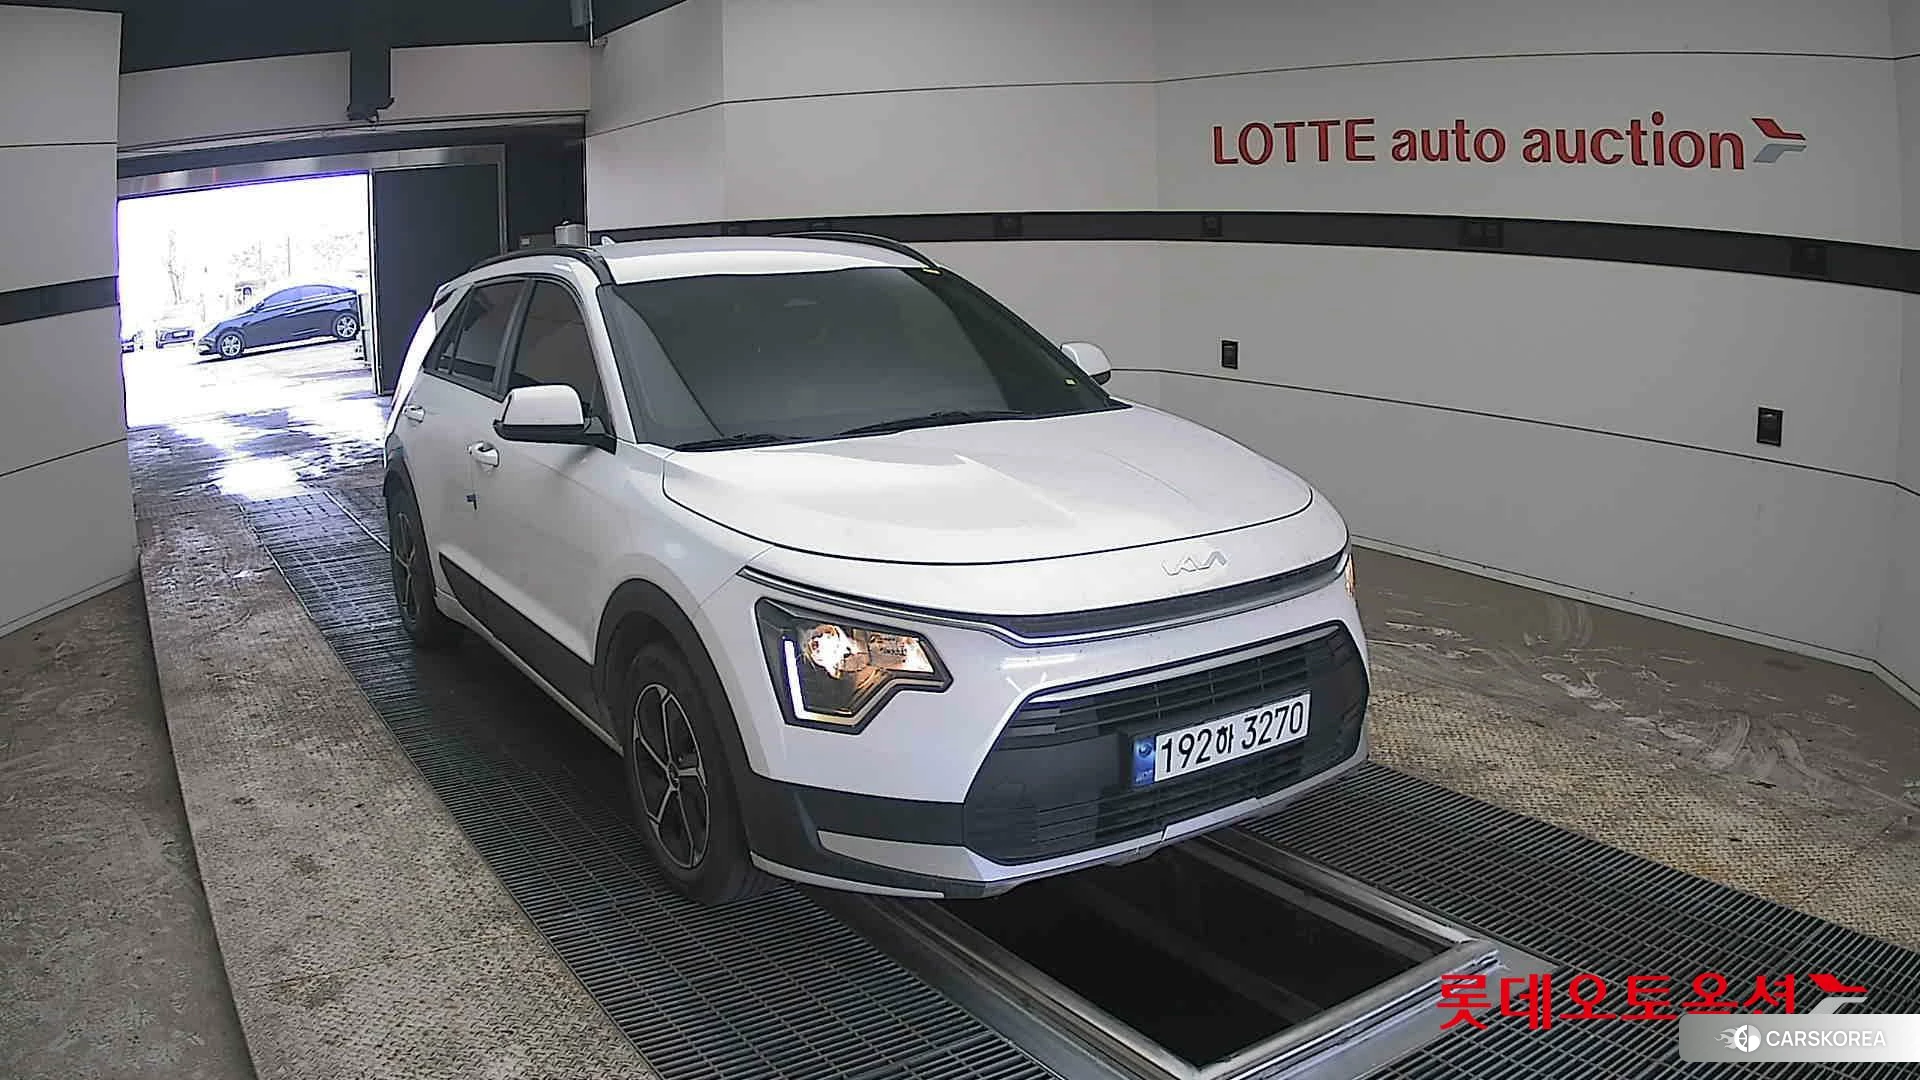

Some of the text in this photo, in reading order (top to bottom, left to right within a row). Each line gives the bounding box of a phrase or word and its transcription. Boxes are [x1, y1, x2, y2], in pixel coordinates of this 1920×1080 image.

[1212, 111, 1745, 170] LOTTE auto auction
[1160, 701, 1304, 773] 192하 3270
